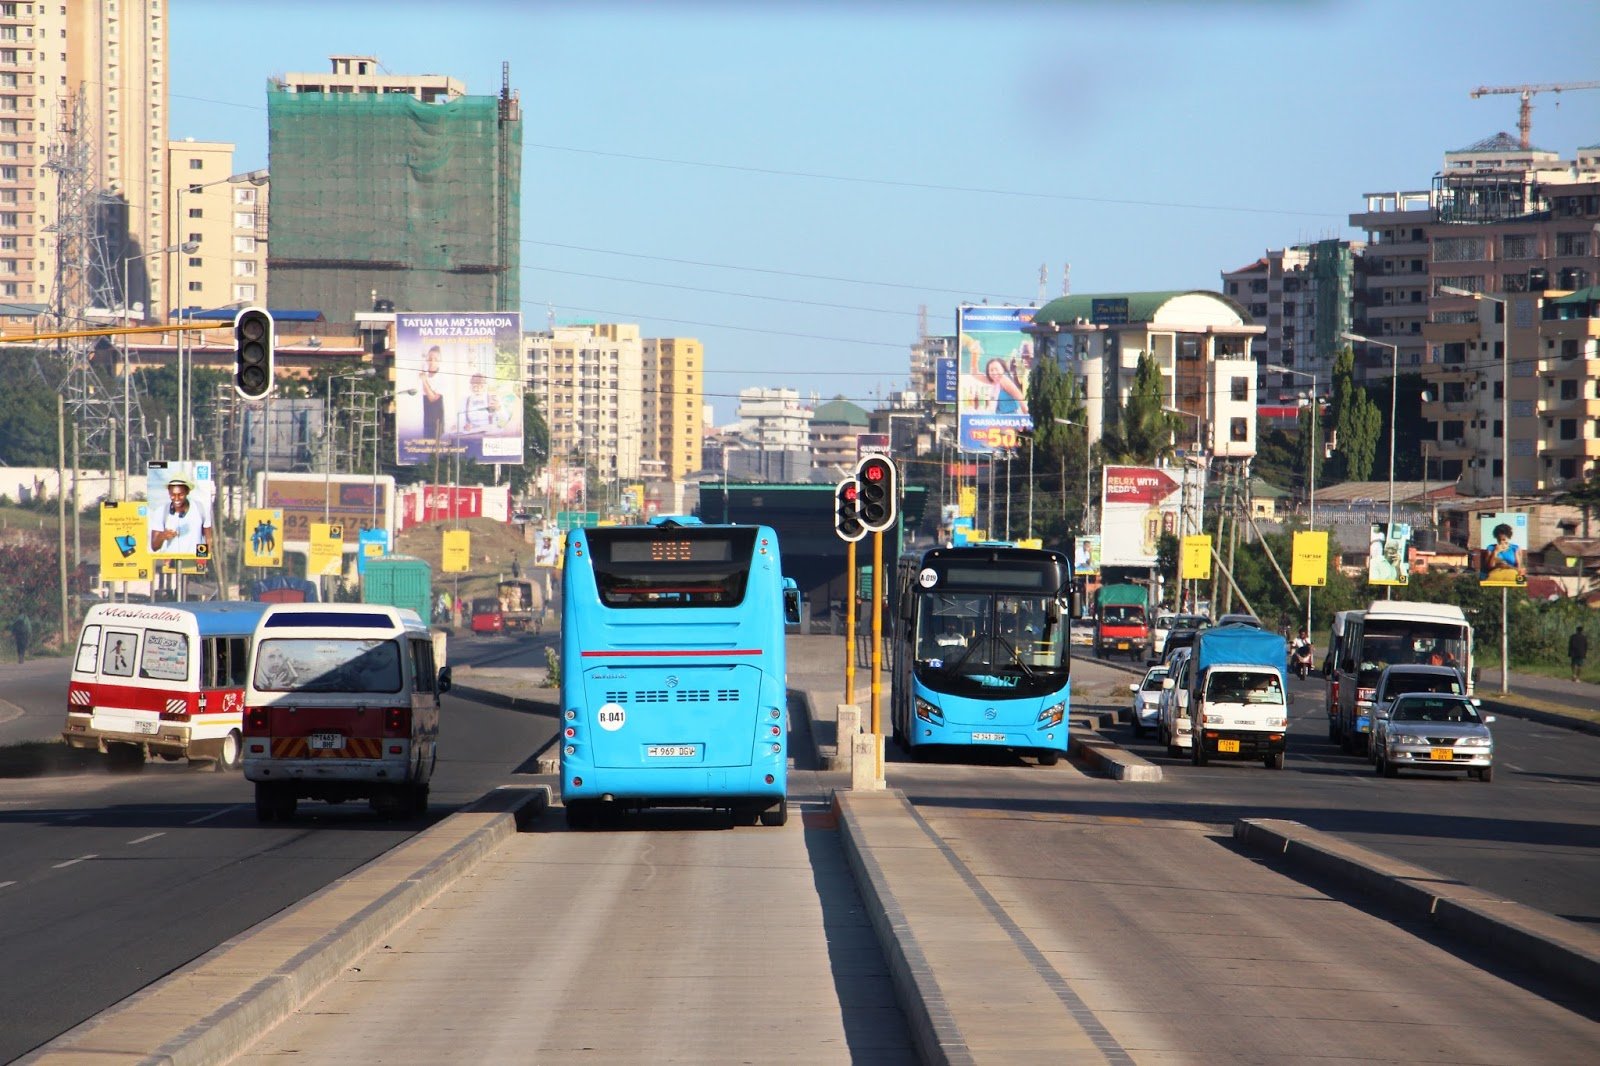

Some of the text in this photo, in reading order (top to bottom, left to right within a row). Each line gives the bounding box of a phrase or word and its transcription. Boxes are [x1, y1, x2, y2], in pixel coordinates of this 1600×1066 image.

[402, 318, 513, 329] TATUA NA MB'S PAMOJA
[419, 327, 433, 336] NA
[450, 327, 463, 336] ZA
[465, 327, 496, 336] ZIADA!
[1107, 477, 1159, 486] RELAX WITH
[660, 747, 675, 756] 969
